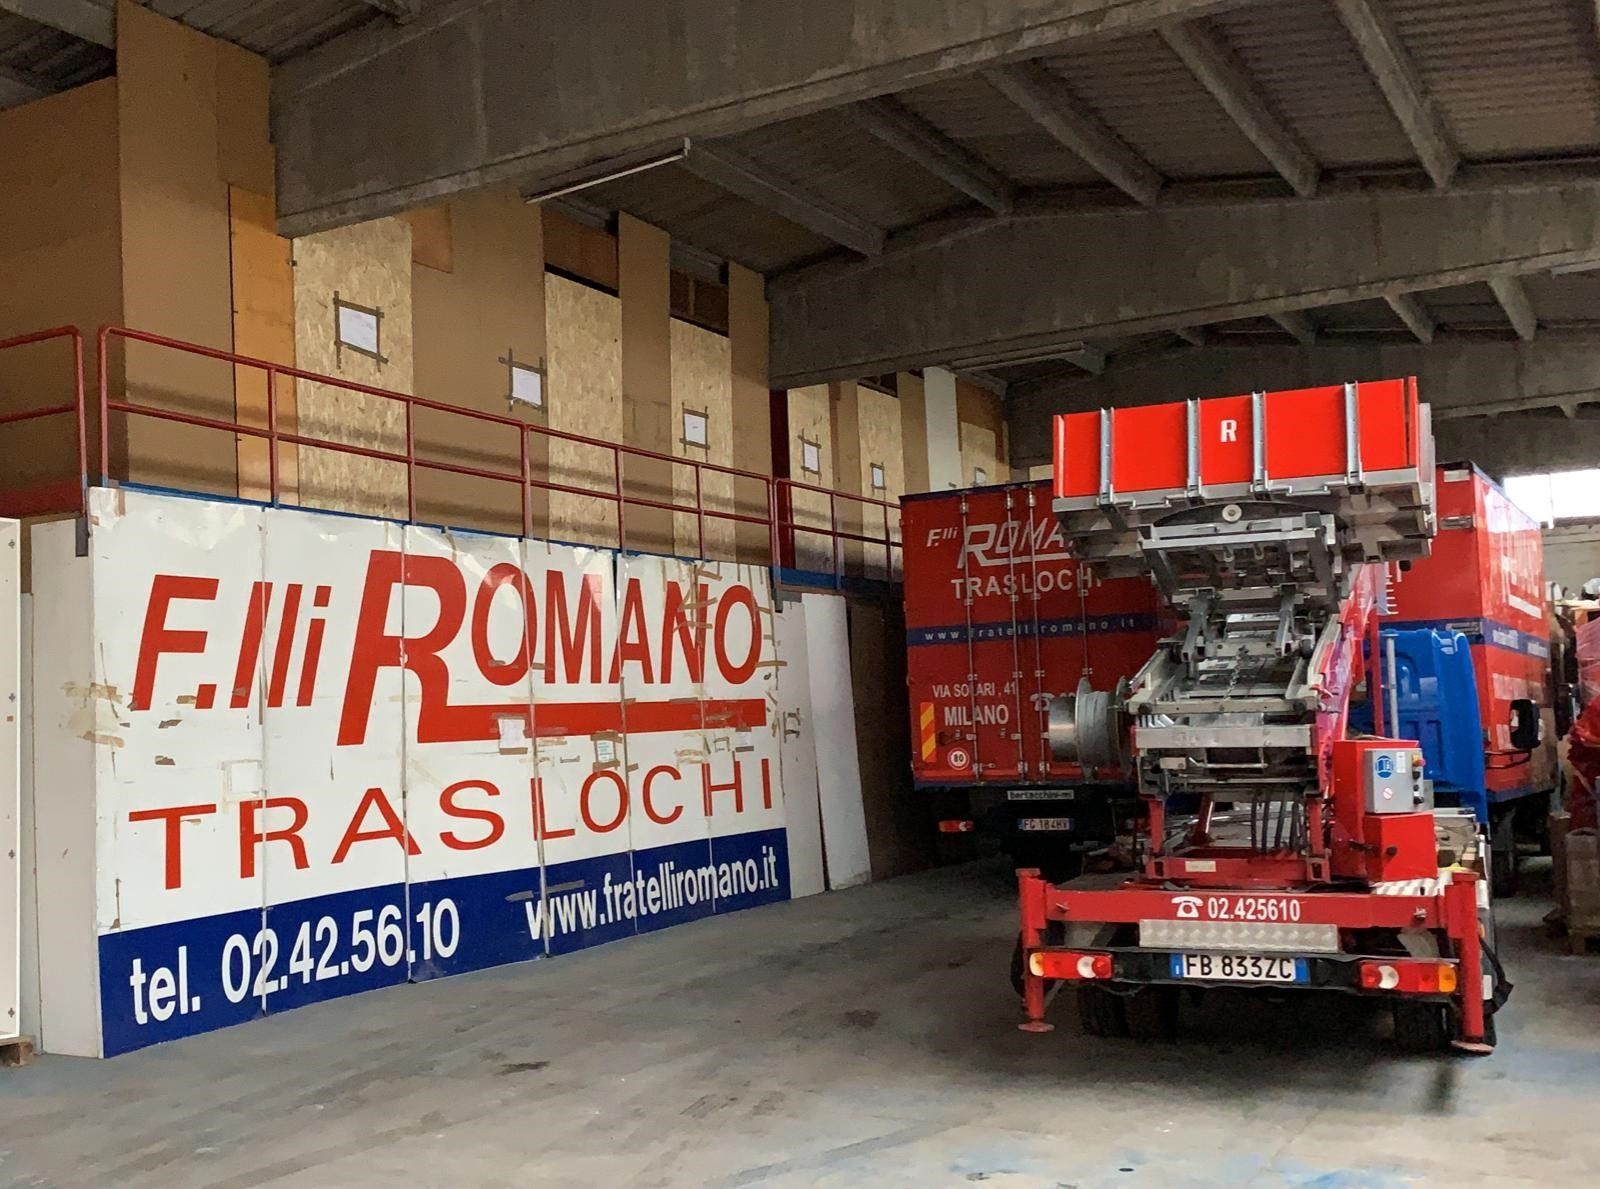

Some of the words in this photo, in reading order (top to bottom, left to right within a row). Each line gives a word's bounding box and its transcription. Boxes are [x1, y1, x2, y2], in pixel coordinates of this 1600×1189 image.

[1220, 419, 1237, 442] R
[957, 517, 1073, 569] ROMA
[924, 618, 1136, 641] www.fratellromano.it
[132, 574, 332, 711] F.lli
[336, 549, 767, 747] ROMANO
[932, 684, 950, 698] VIA
[1004, 681, 1016, 694] 41
[944, 704, 1009, 726] MILANO
[129, 757, 773, 890] TRASLOCHI
[525, 845, 779, 940] www.fratelliromano.it
[1207, 897, 1300, 921] 02.425610
[130, 946, 201, 1025] tel.
[222, 898, 460, 1003] 02.42.56.10
[1186, 955, 1212, 976] FB
[1221, 956, 1292, 979] 833ZC
